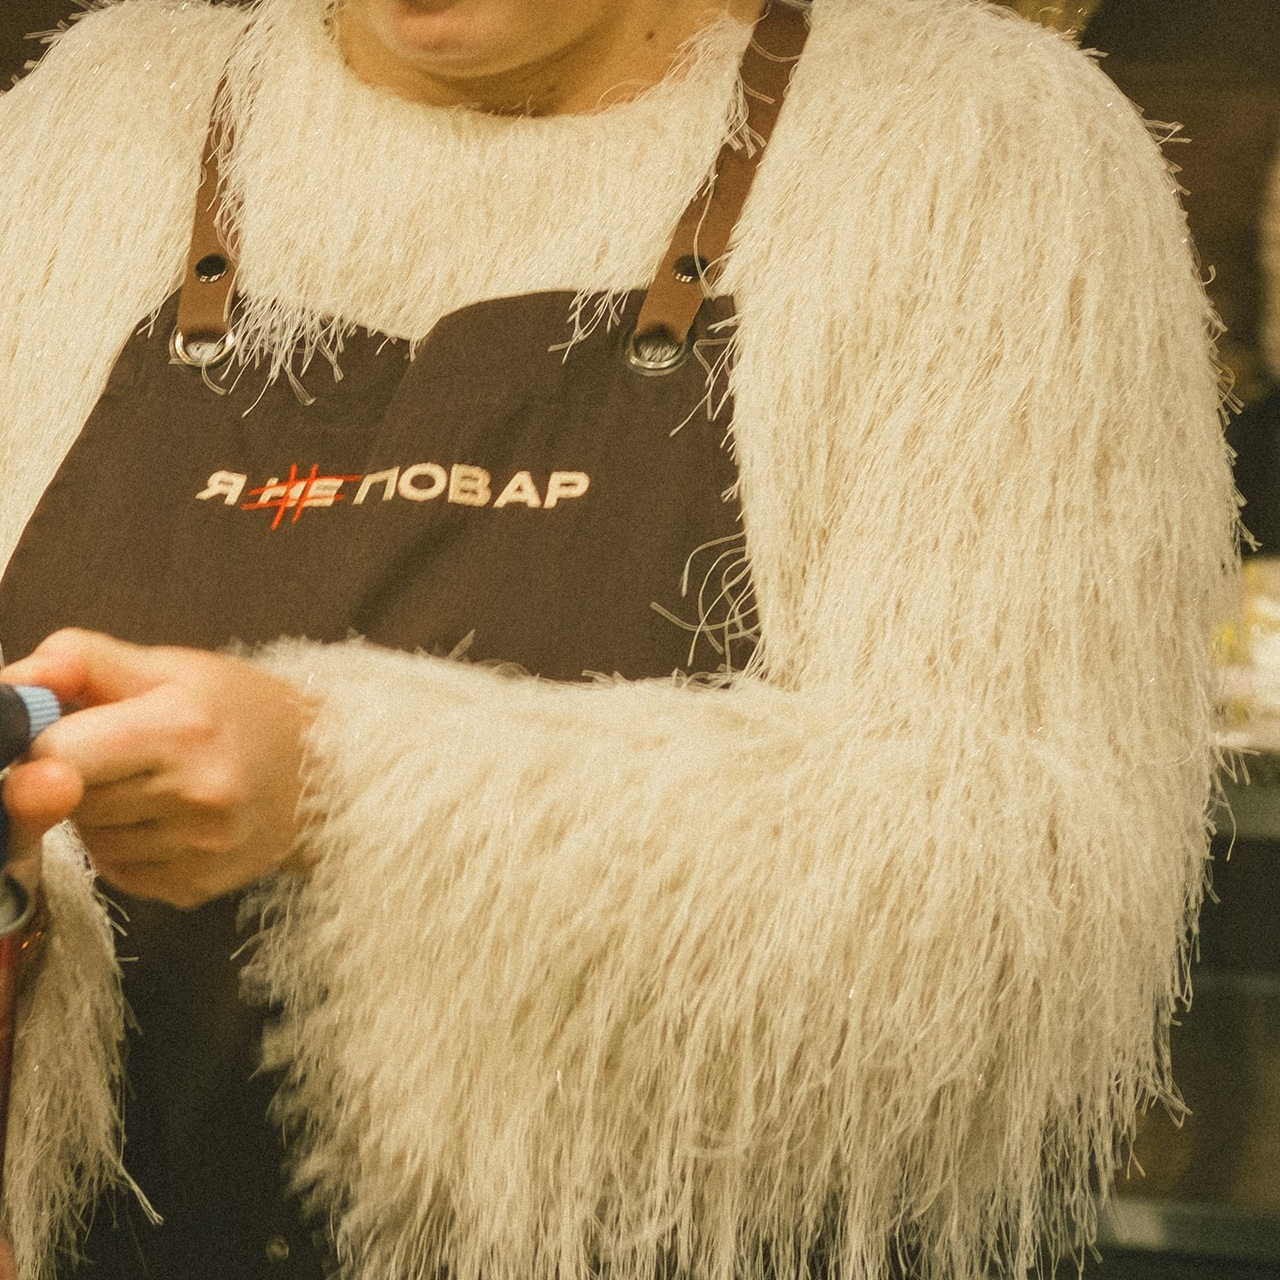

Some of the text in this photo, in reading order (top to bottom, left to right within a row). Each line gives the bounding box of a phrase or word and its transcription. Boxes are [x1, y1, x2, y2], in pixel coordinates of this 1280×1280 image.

[194, 461, 591, 510] Я НЕ ПОВАР
